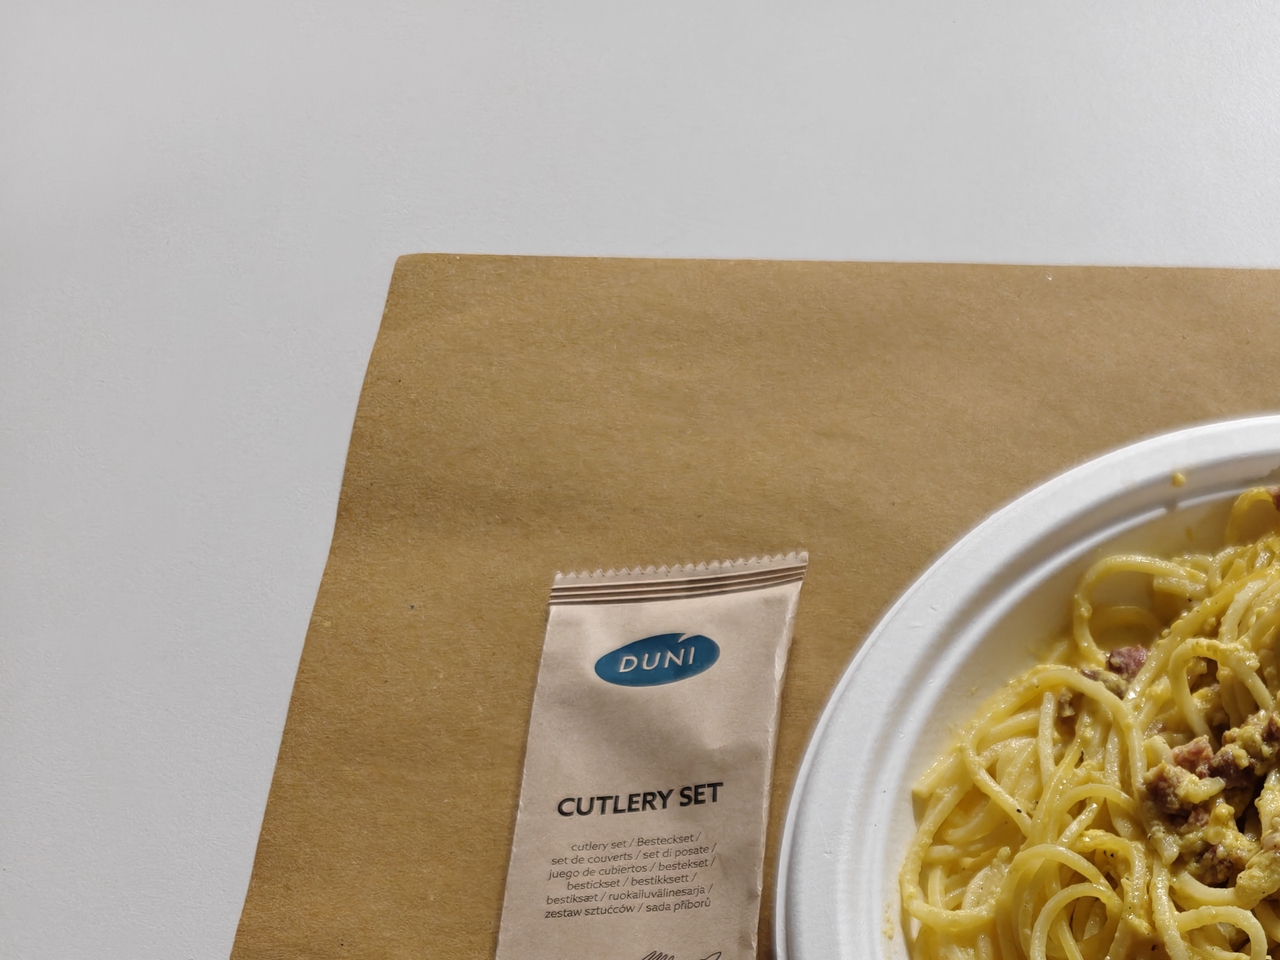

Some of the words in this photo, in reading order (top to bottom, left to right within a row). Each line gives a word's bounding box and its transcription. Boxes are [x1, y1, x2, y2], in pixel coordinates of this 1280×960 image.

[618, 646, 695, 673] DUNI
[557, 788, 675, 817] CUTLERY
[679, 782, 724, 807] SET
[571, 840, 608, 852] cutlery
[610, 840, 627, 849] set
[637, 834, 694, 846] Besteckset
[551, 857, 568, 865] set
[571, 855, 585, 865] de
[587, 853, 633, 863] couverts
[642, 849, 659, 859] set
[662, 848, 672, 858] di
[674, 845, 709, 859] posate
[548, 869, 580, 881] juego
[582, 867, 596, 877] de
[598, 865, 648, 875] cubiertos
[658, 858, 709, 871] bestekset
[567, 879, 621, 891] bestickset
[631, 874, 689, 886] bestikksett
[546, 894, 599, 905] bestiksæt
[544, 908, 582, 919] zestaw
[584, 904, 636, 916] sztućców
[645, 902, 672, 912] sada
